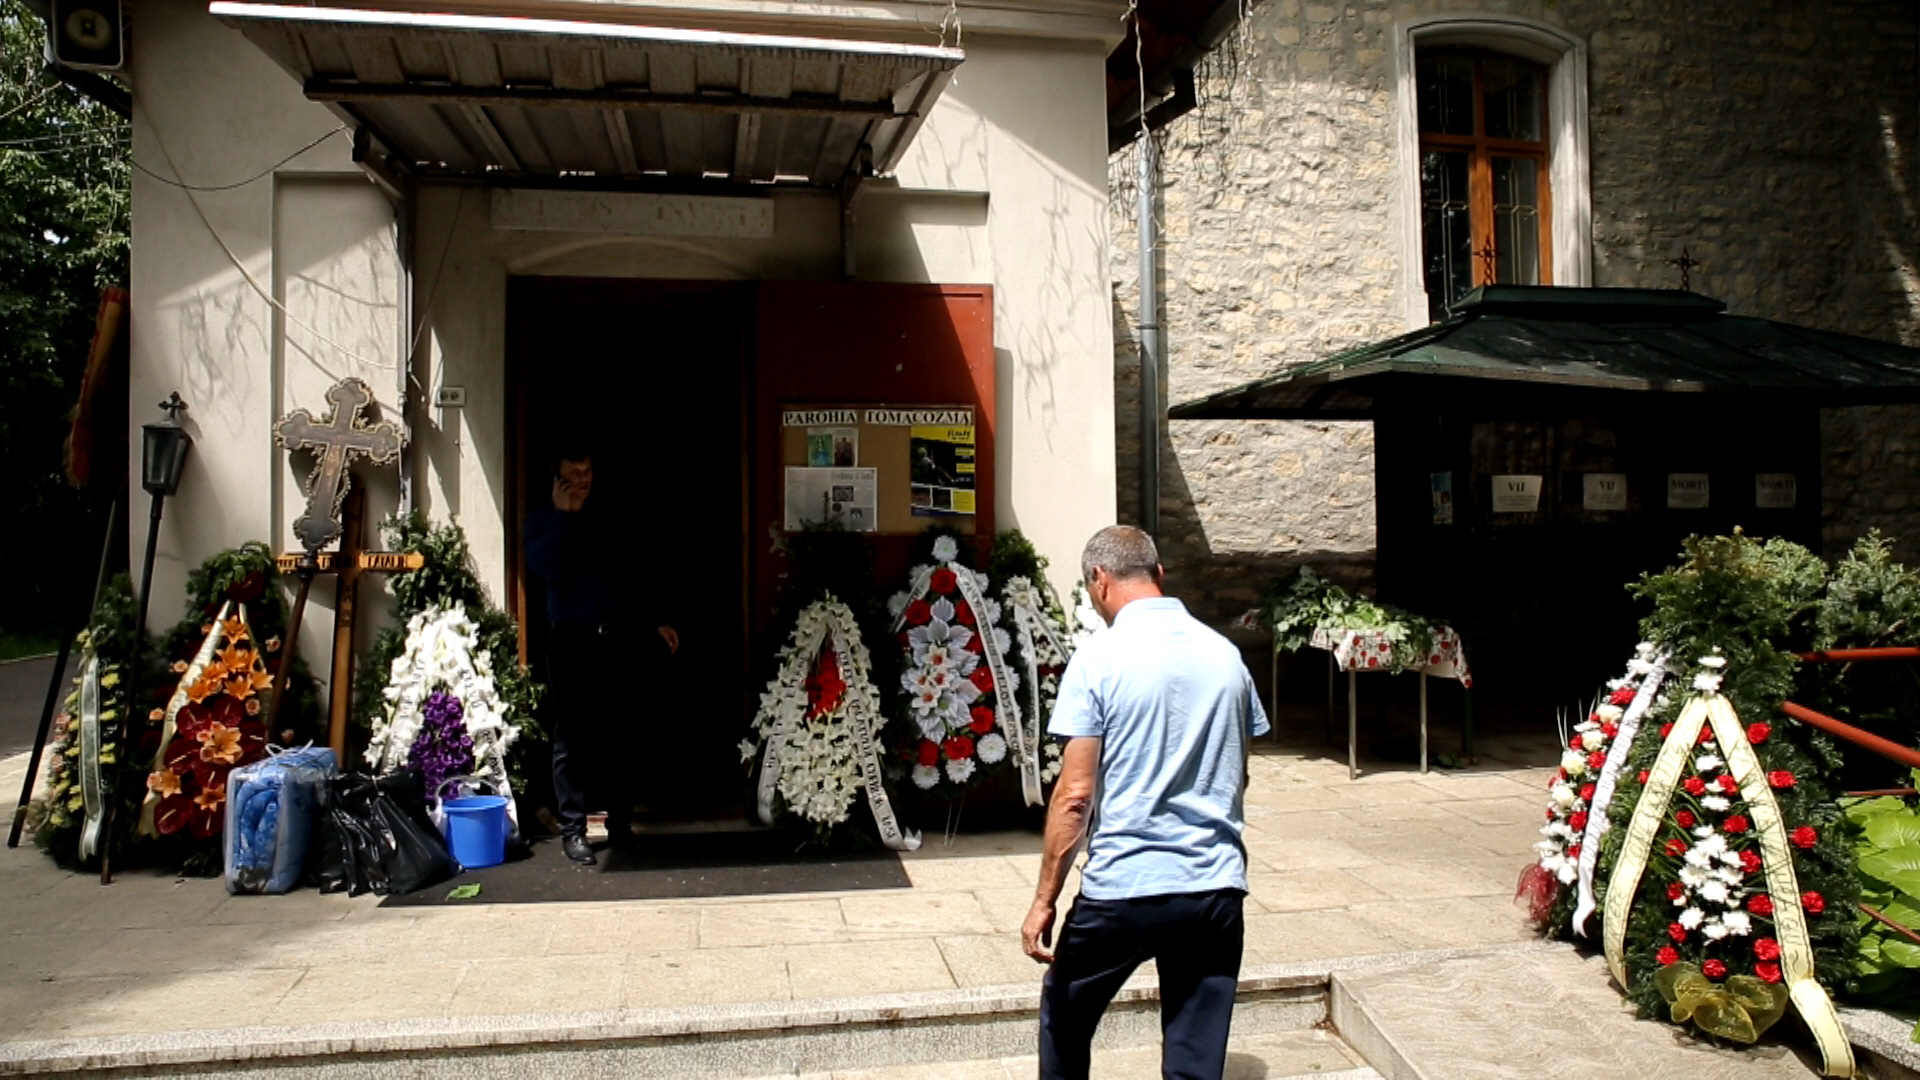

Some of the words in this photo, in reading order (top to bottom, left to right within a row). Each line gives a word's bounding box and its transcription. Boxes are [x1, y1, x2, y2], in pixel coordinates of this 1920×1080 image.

[784, 411, 857, 425] PAROHIA
[1508, 482, 1525, 492] VII
[1599, 480, 1615, 490] VII
